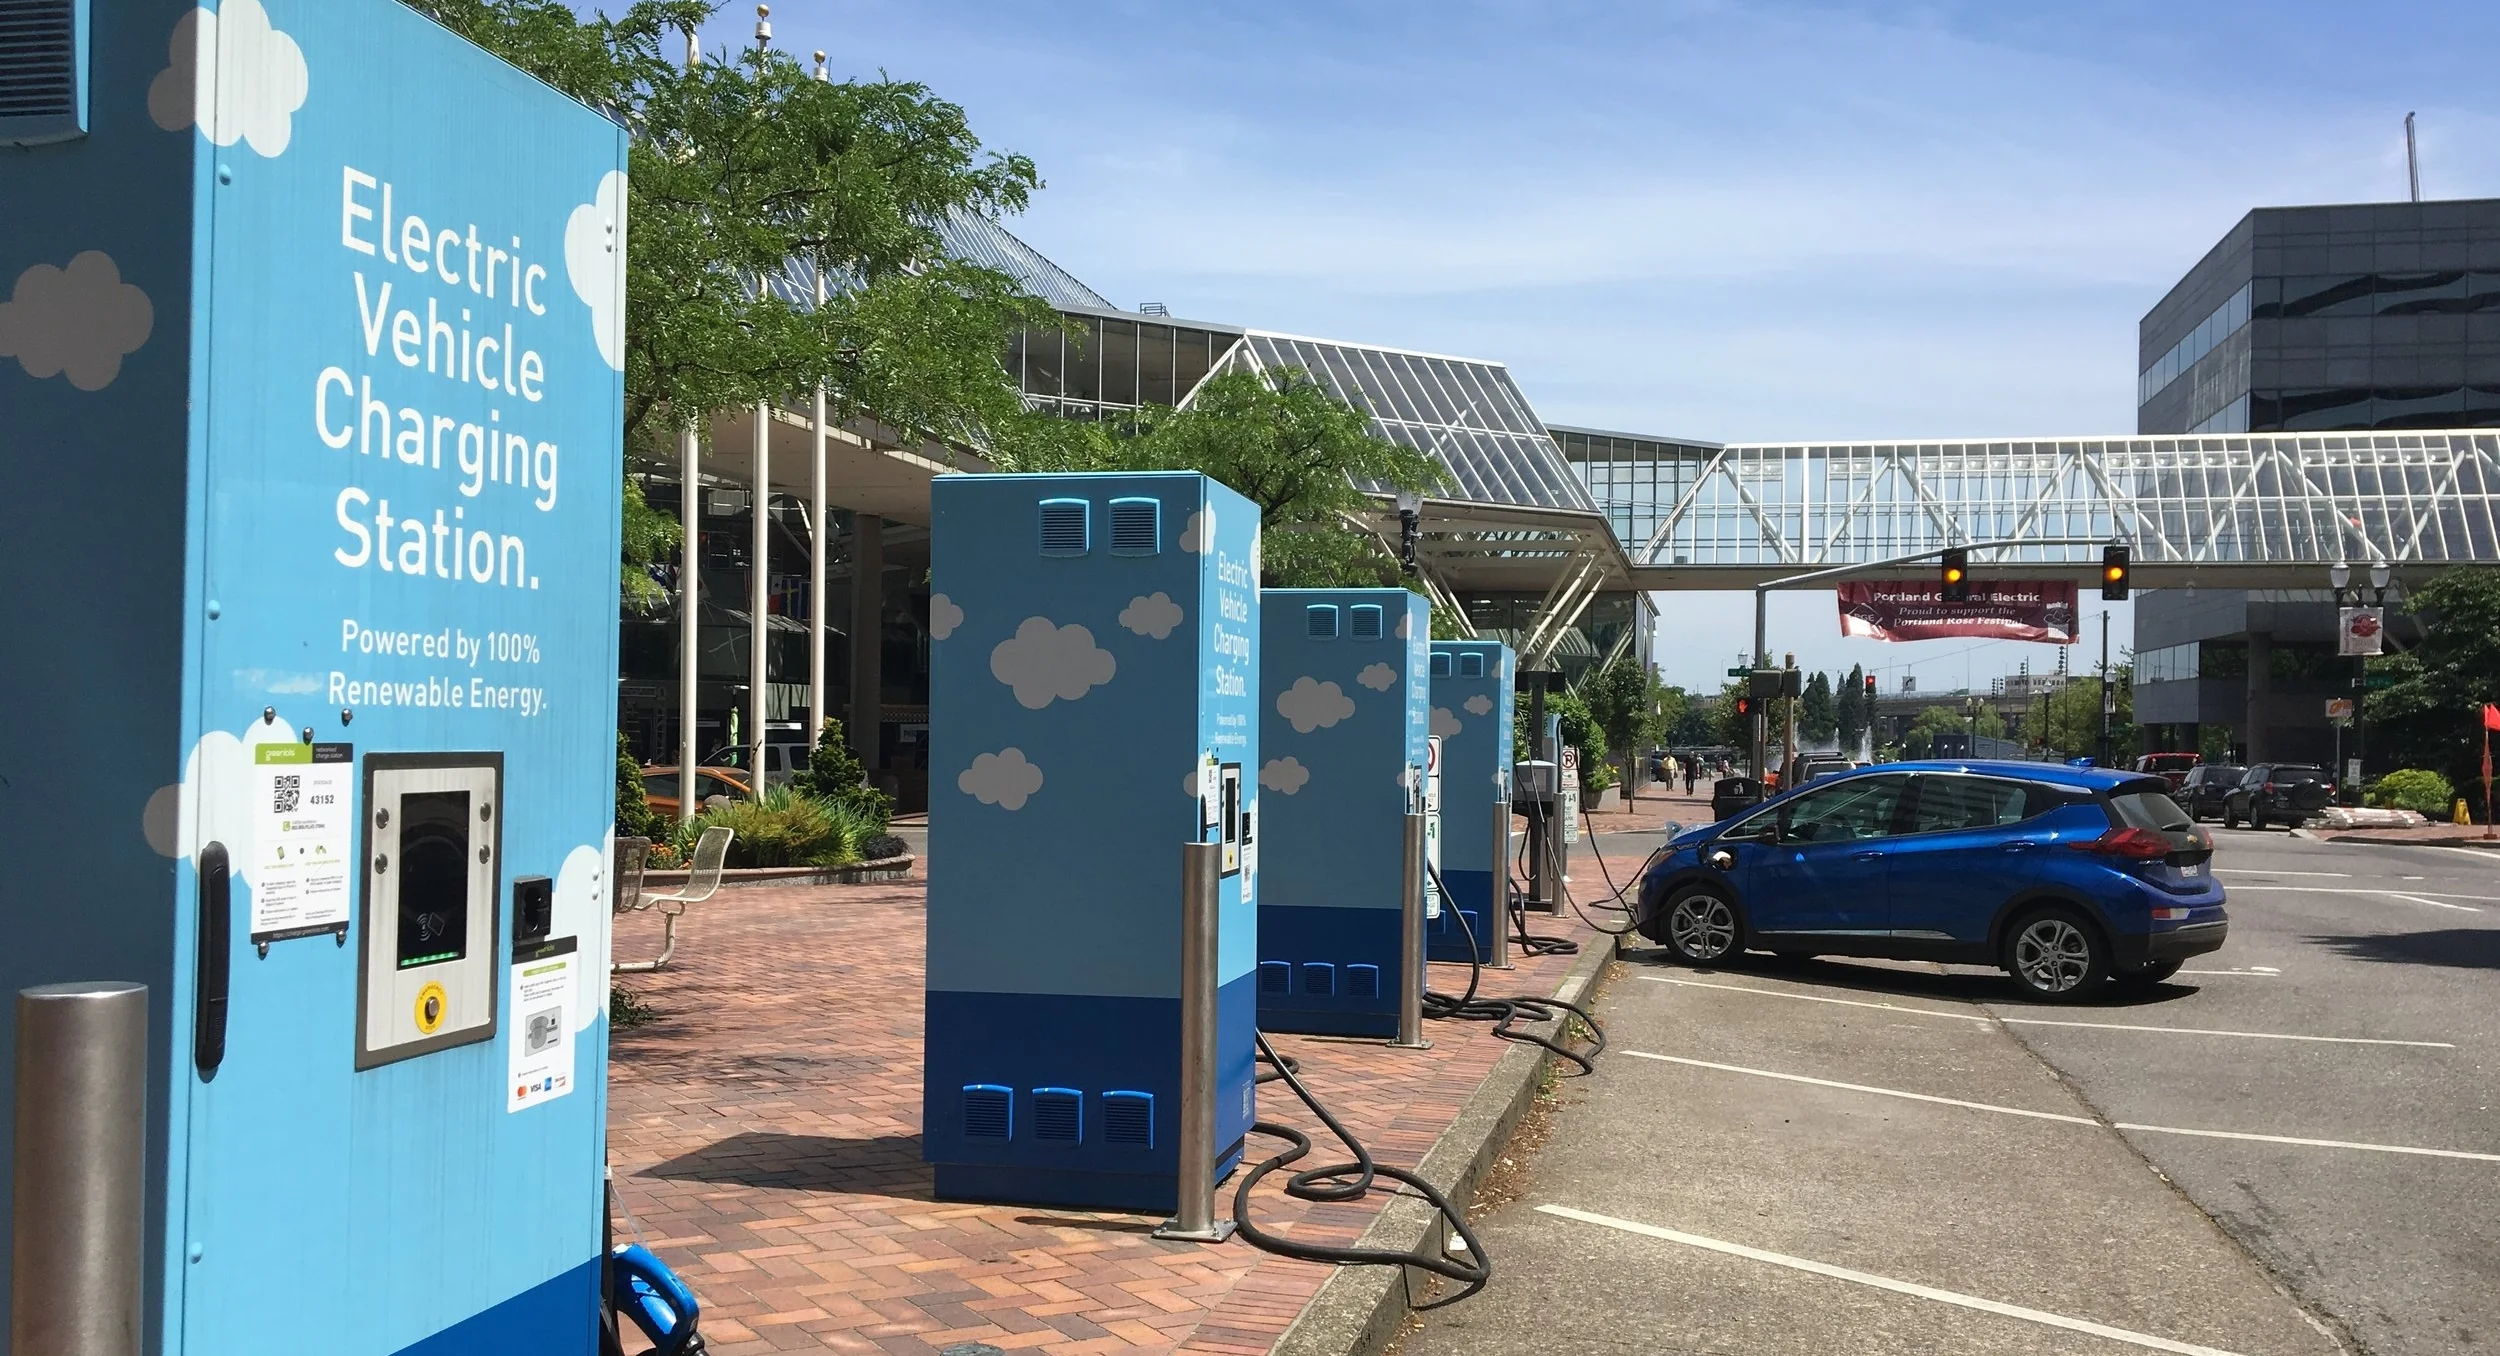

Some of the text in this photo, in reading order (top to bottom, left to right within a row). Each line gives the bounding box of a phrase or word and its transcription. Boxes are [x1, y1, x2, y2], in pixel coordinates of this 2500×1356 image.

[342, 165, 547, 316] Electric
[354, 271, 544, 402] Vehicle
[315, 366, 558, 512] Charging
[334, 486, 540, 590] Station.
[1218, 551, 1248, 589] Electric
[1219, 587, 1248, 624] Vehicle
[1874, 592, 2040, 602] Portland Gral Electric
[1899, 606, 2016, 616] Proud to support the
[1893, 618, 1943, 627] Portland
[1946, 617, 1975, 625] Rose
[342, 619, 540, 667] Powered by 100%
[1214, 623, 1249, 666] Charging
[329, 671, 547, 716] Renewable Energy.
[1215, 665, 1247, 697] Station.
[310, 795, 334, 804] 43152
[530, 1082, 542, 1093] VISA
